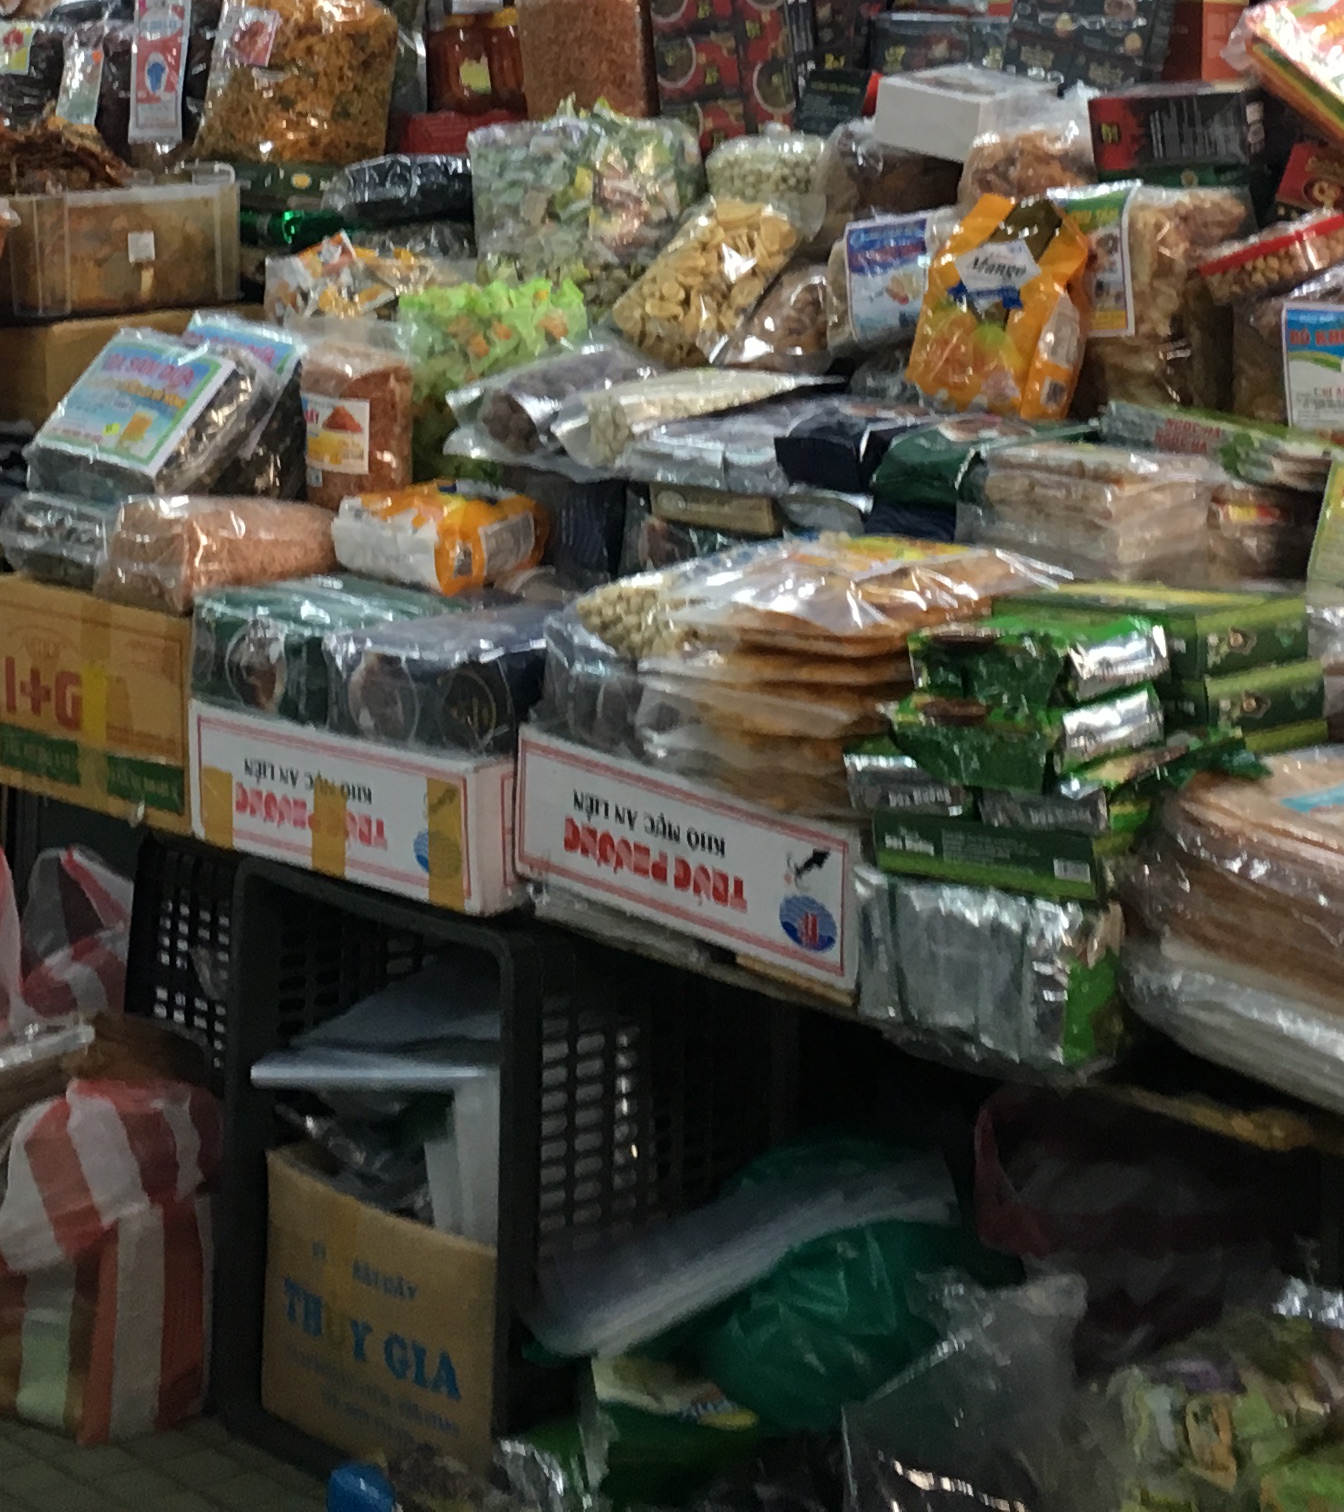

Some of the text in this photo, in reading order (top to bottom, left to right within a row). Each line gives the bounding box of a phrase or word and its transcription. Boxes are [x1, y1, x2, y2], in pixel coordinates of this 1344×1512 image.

[970, 254, 1028, 281] Mango
[686, 825, 727, 858] KHÔ
[283, 1275, 374, 1364] THY
[383, 1331, 462, 1402] GIA
